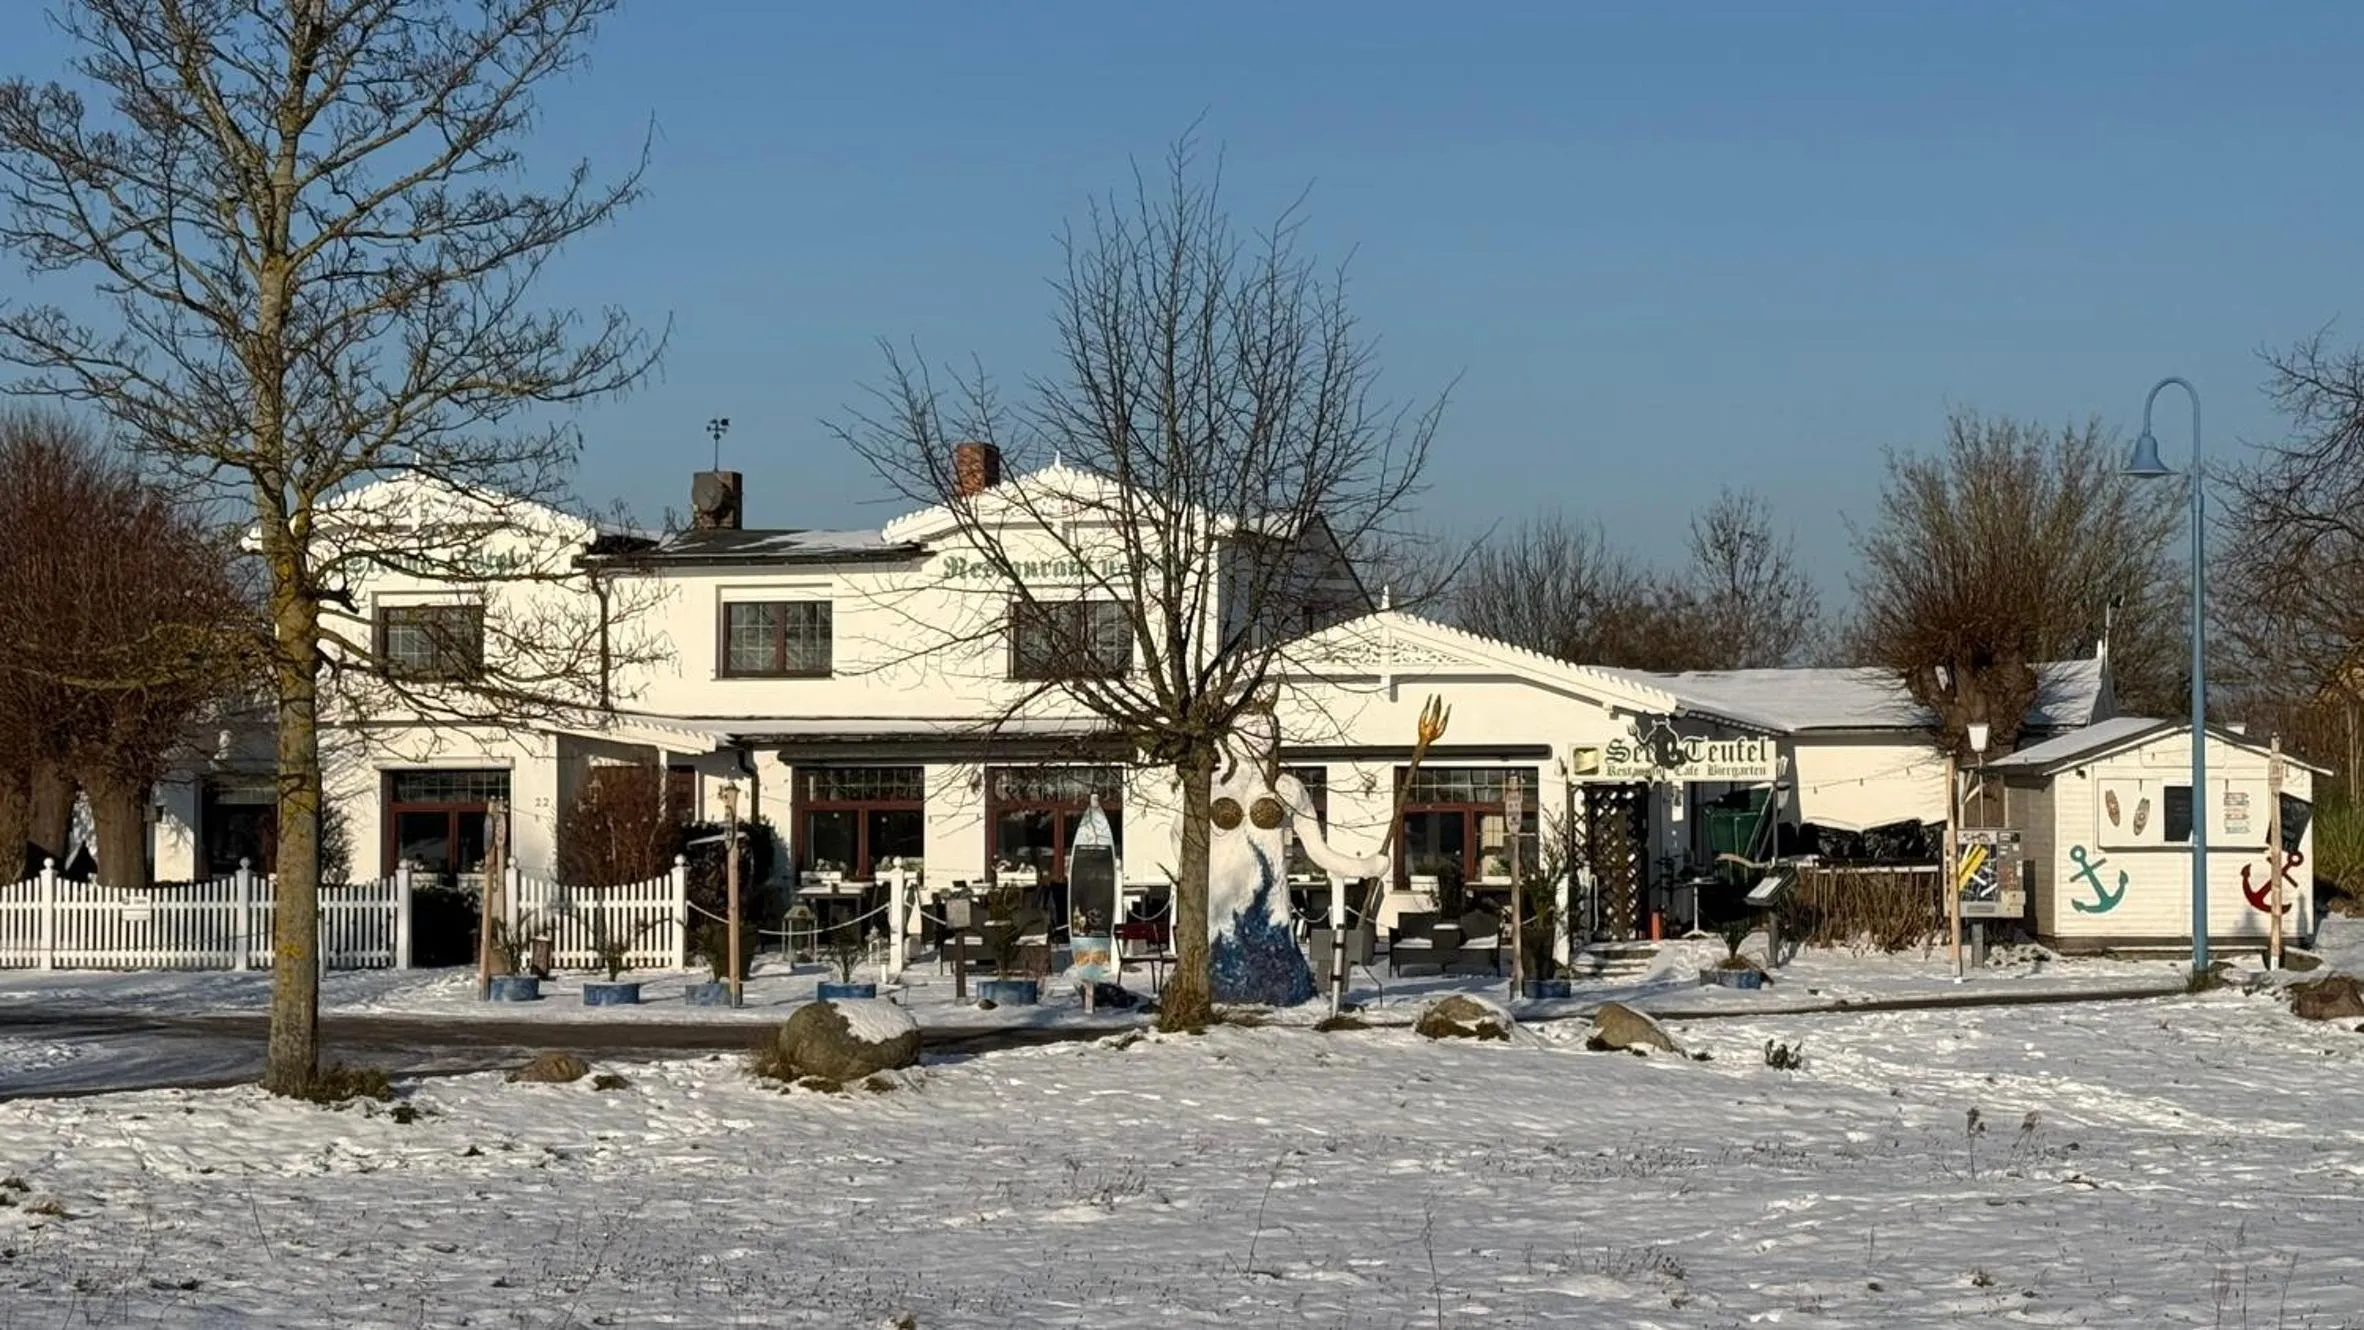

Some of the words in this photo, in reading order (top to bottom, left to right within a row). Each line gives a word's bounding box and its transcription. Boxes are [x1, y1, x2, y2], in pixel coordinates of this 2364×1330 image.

[943, 556, 1094, 579] Resauran
[1682, 737, 1768, 763] Teufel
[1606, 765, 1665, 778] Restaur
